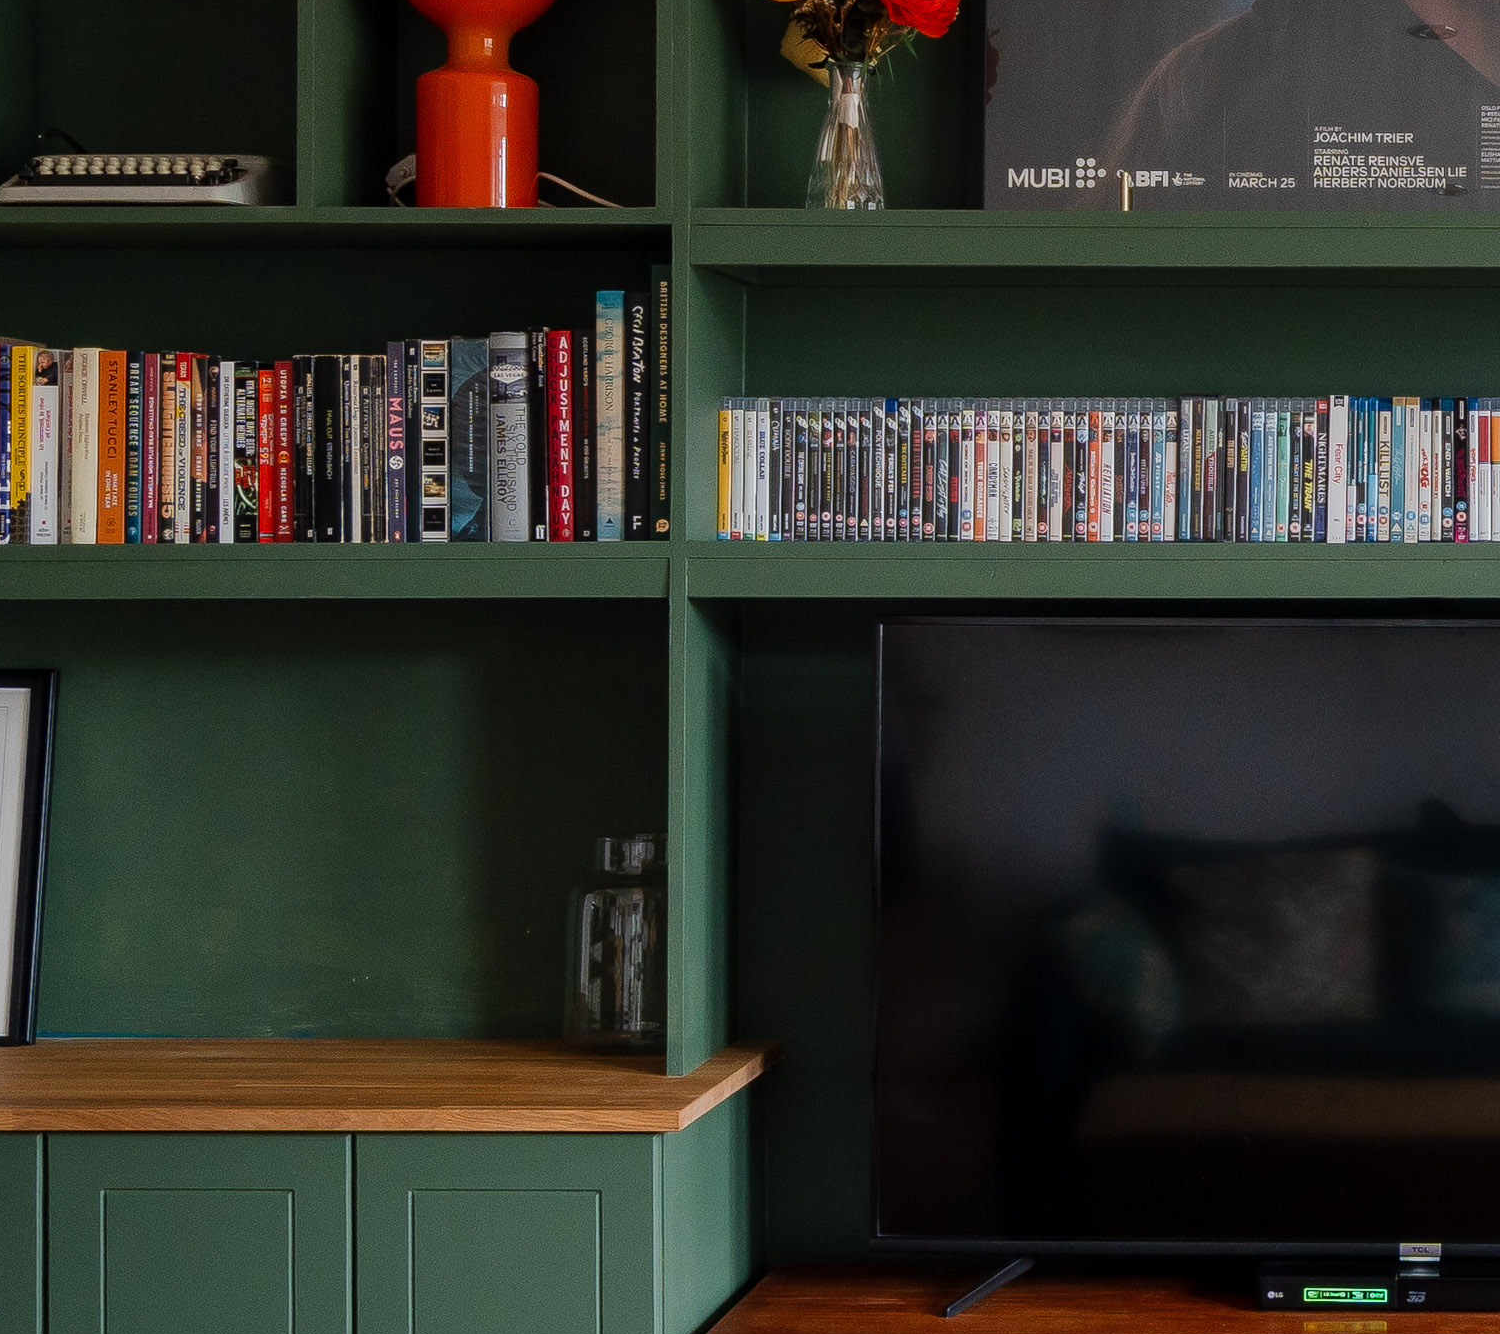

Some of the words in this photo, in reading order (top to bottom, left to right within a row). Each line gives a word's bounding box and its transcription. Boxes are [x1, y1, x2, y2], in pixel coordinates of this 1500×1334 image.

[1313, 133, 1373, 143] JOACHIM
[1375, 133, 1414, 143] TRIER
[1313, 156, 1365, 166] RENATE
[1368, 156, 1424, 166] REINSVE
[1313, 167, 1367, 177] ANDERS
[1370, 167, 1444, 177] DANIELSEN
[1448, 167, 1467, 177] LIE
[1008, 168, 1070, 189] MUBI
[1135, 171, 1169, 187] BFI
[1228, 178, 1277, 188] MARCH
[1281, 178, 1296, 188] 25
[1313, 178, 1375, 188] HERBERT
[1378, 178, 1446, 188] NORDRUM
[660, 281, 668, 319] BRITISH
[659, 323, 667, 376] DESIGNERS
[107, 360, 118, 418] STANLEY
[659, 380, 667, 393] AT
[559, 336, 570, 475] ADJUSTMENT
[659, 395, 667, 423] HOME
[389, 397, 404, 450] MAUS
[495, 414, 506, 458] JAMES
[107, 420, 117, 460] TUCCI
[1335, 443, 1343, 467] Fear
[497, 459, 508, 504] ELLROY
[1332, 467, 1343, 485] City
[559, 484, 571, 526] DAY
